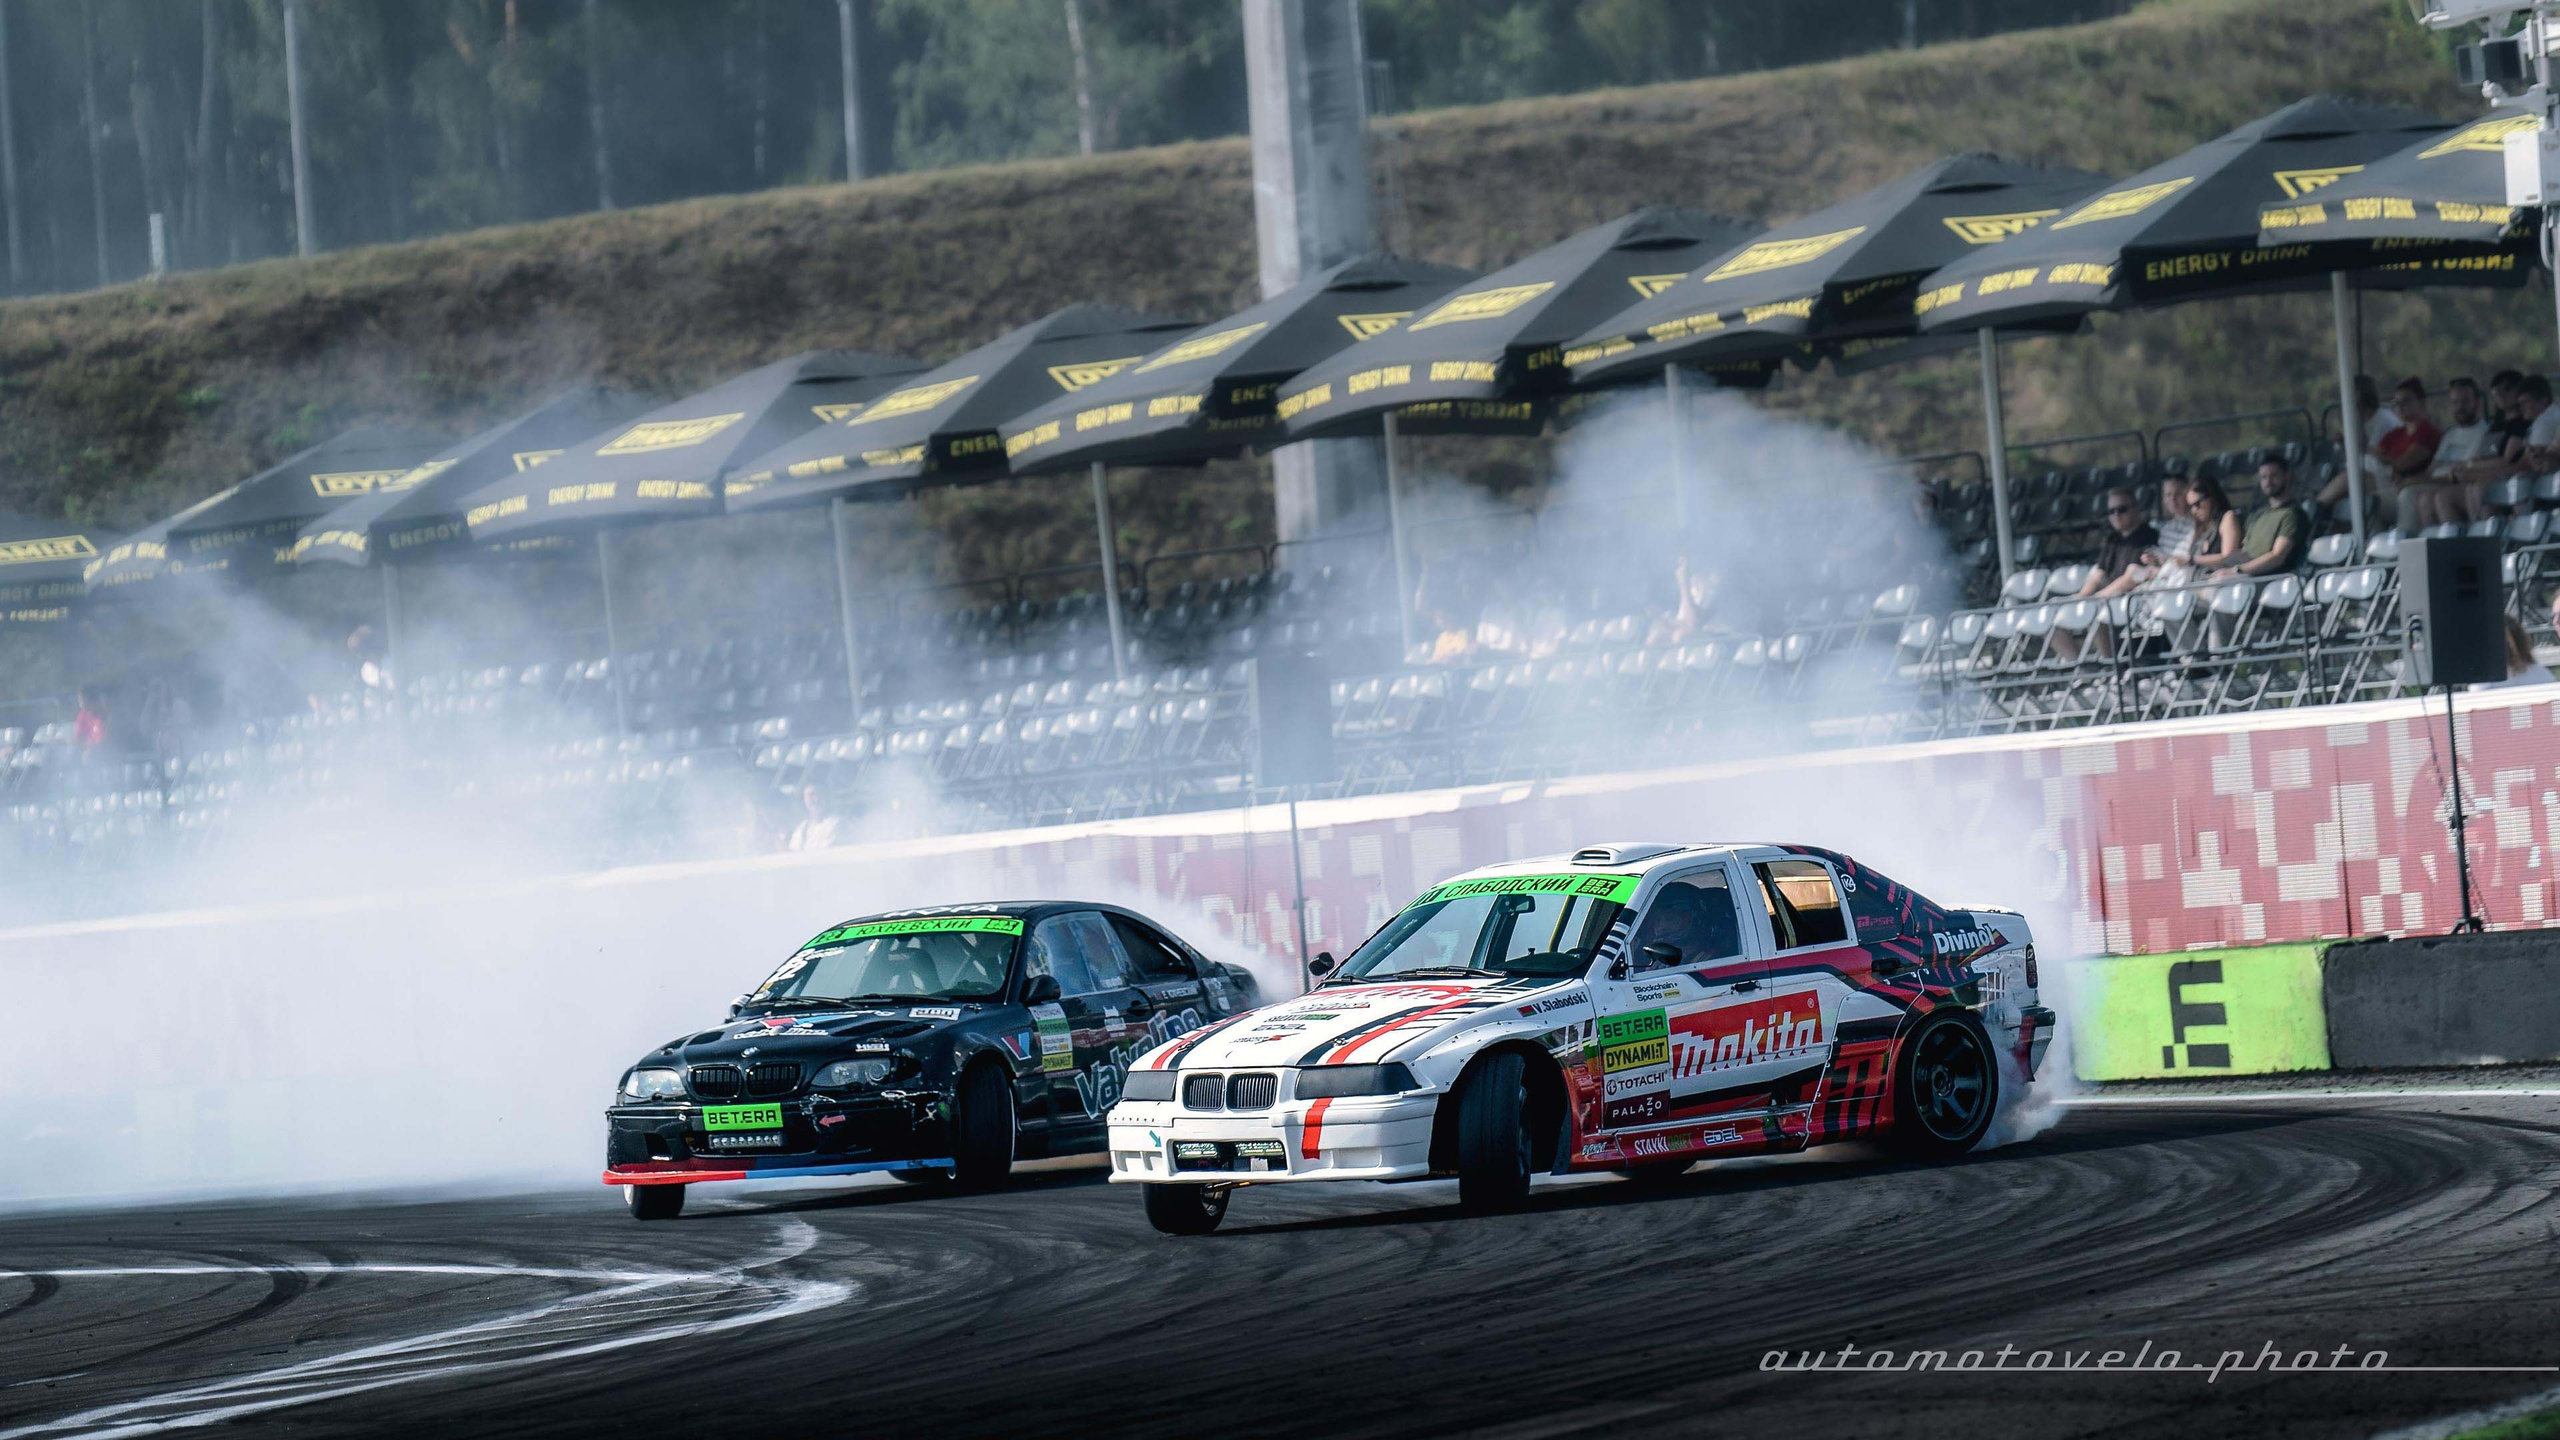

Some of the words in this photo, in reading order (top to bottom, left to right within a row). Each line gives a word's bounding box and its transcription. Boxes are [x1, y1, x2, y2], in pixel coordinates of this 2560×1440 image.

[2146, 251, 2231, 281] ENERGY
[1933, 923, 1995, 954] Divinol
[1633, 982, 1674, 993] Blockchain
[1636, 992, 1663, 1002] Sports
[1603, 1014, 1665, 1039] BET.ERA
[1606, 1042, 1665, 1067] DYNAMI:T
[1617, 1072, 1665, 1090] TOTACHI
[708, 1109, 777, 1125] BET.ERA
[1612, 1097, 1662, 1117] PALAZZO
